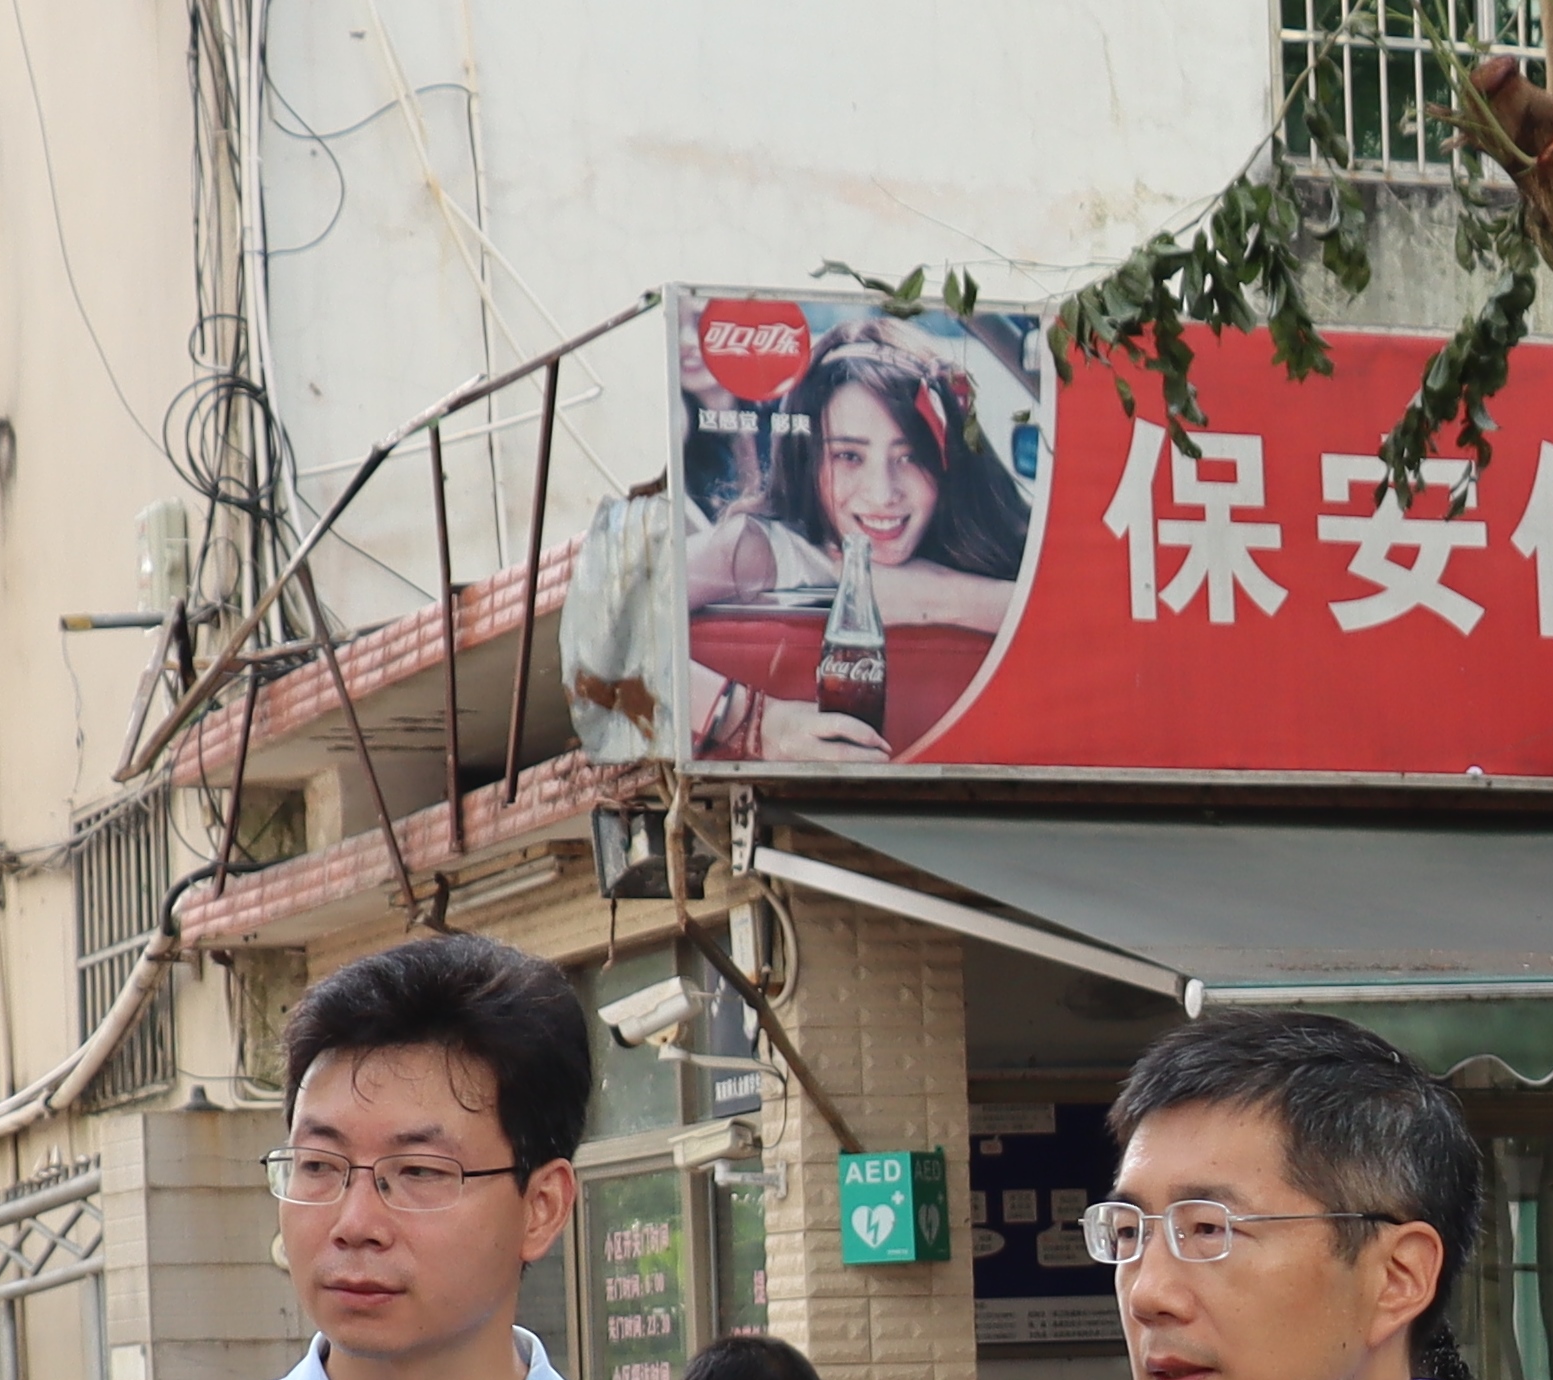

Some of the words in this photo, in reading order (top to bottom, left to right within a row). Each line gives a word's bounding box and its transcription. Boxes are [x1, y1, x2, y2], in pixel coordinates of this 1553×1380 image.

[704, 321, 805, 356] 可口可乐
[698, 408, 758, 431] 这感觉
[771, 412, 810, 434] 够爽
[845, 1159, 902, 1184] AED
